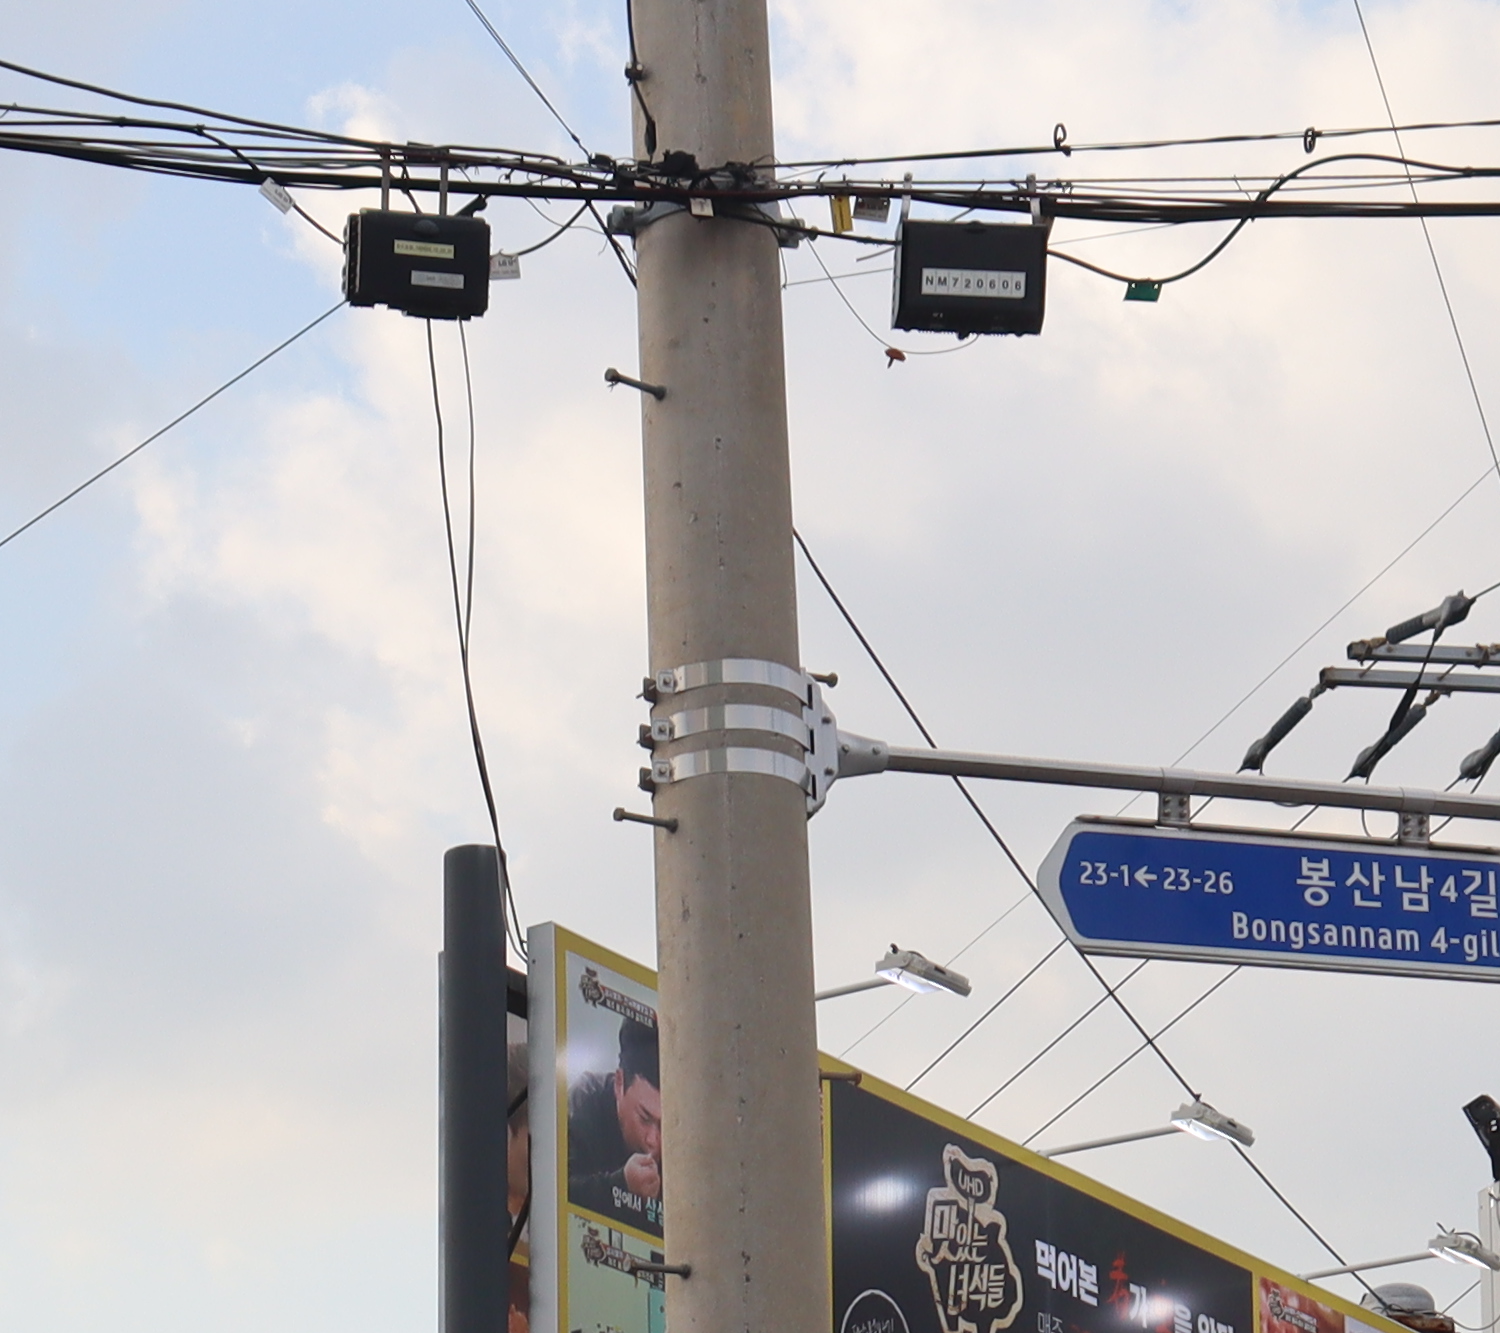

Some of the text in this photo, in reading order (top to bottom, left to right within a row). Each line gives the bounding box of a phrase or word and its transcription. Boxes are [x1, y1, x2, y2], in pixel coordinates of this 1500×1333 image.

[1079, 860, 1234, 895] 23-1 23-26
[1296, 856, 1498, 919] 봉산남4길
[1231, 910, 1500, 962] Bongsannam 4-gil
[957, 1169, 984, 1196] UHD
[932, 1201, 988, 1265] 맛있는
[948, 1262, 1006, 1317] 녀석들
[1035, 1240, 1099, 1307] 먹어본
